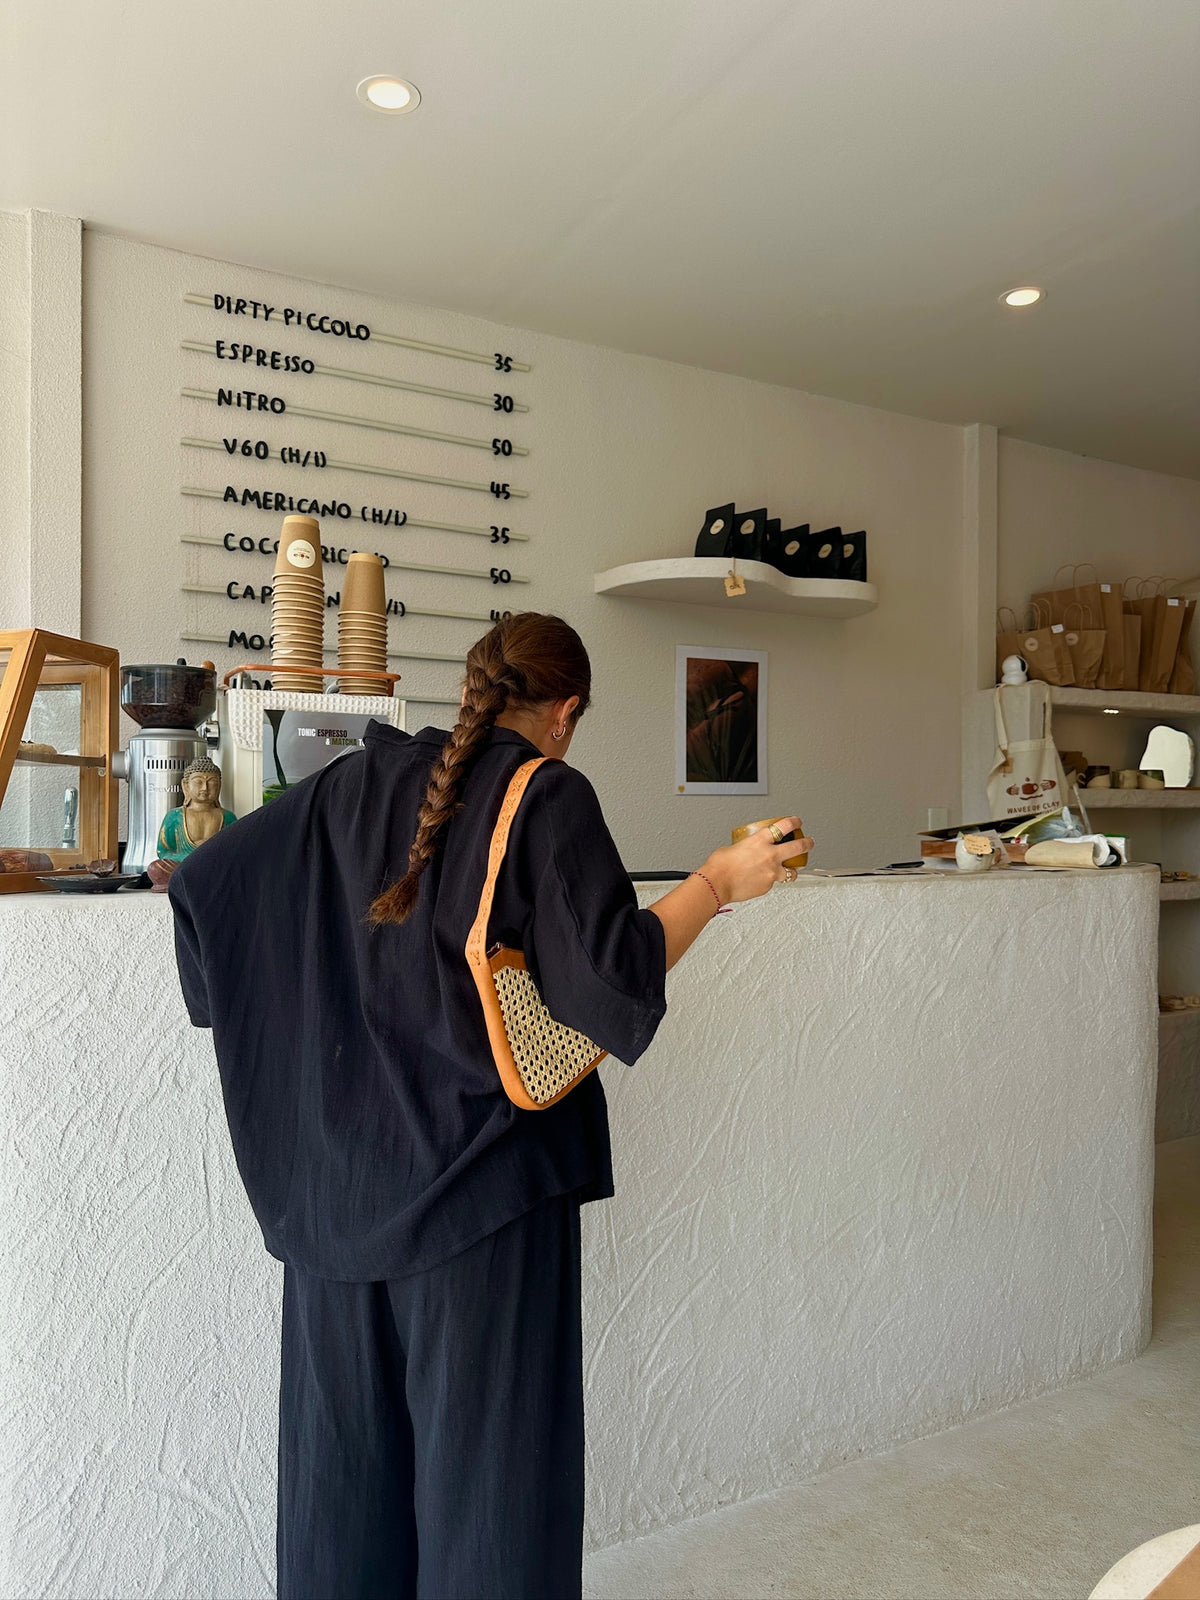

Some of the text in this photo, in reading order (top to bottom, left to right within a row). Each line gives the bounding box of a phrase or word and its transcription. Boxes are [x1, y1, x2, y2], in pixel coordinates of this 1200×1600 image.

[284, 308, 371, 341] PICCOLO
[494, 354, 514, 373] 35
[215, 340, 514, 414] ESPRESSO 30
[491, 438, 513, 457] 50
[222, 438, 269, 460] V60
[490, 481, 511, 500] 45
[489, 526, 511, 544] 35
[490, 568, 512, 585] 50
[297, 727, 348, 738] TONIC ESPRESSO
[325, 738, 331, 746] &
[331, 737, 357, 746] MATCHA
[1042, 800, 1060, 810] CLAY
